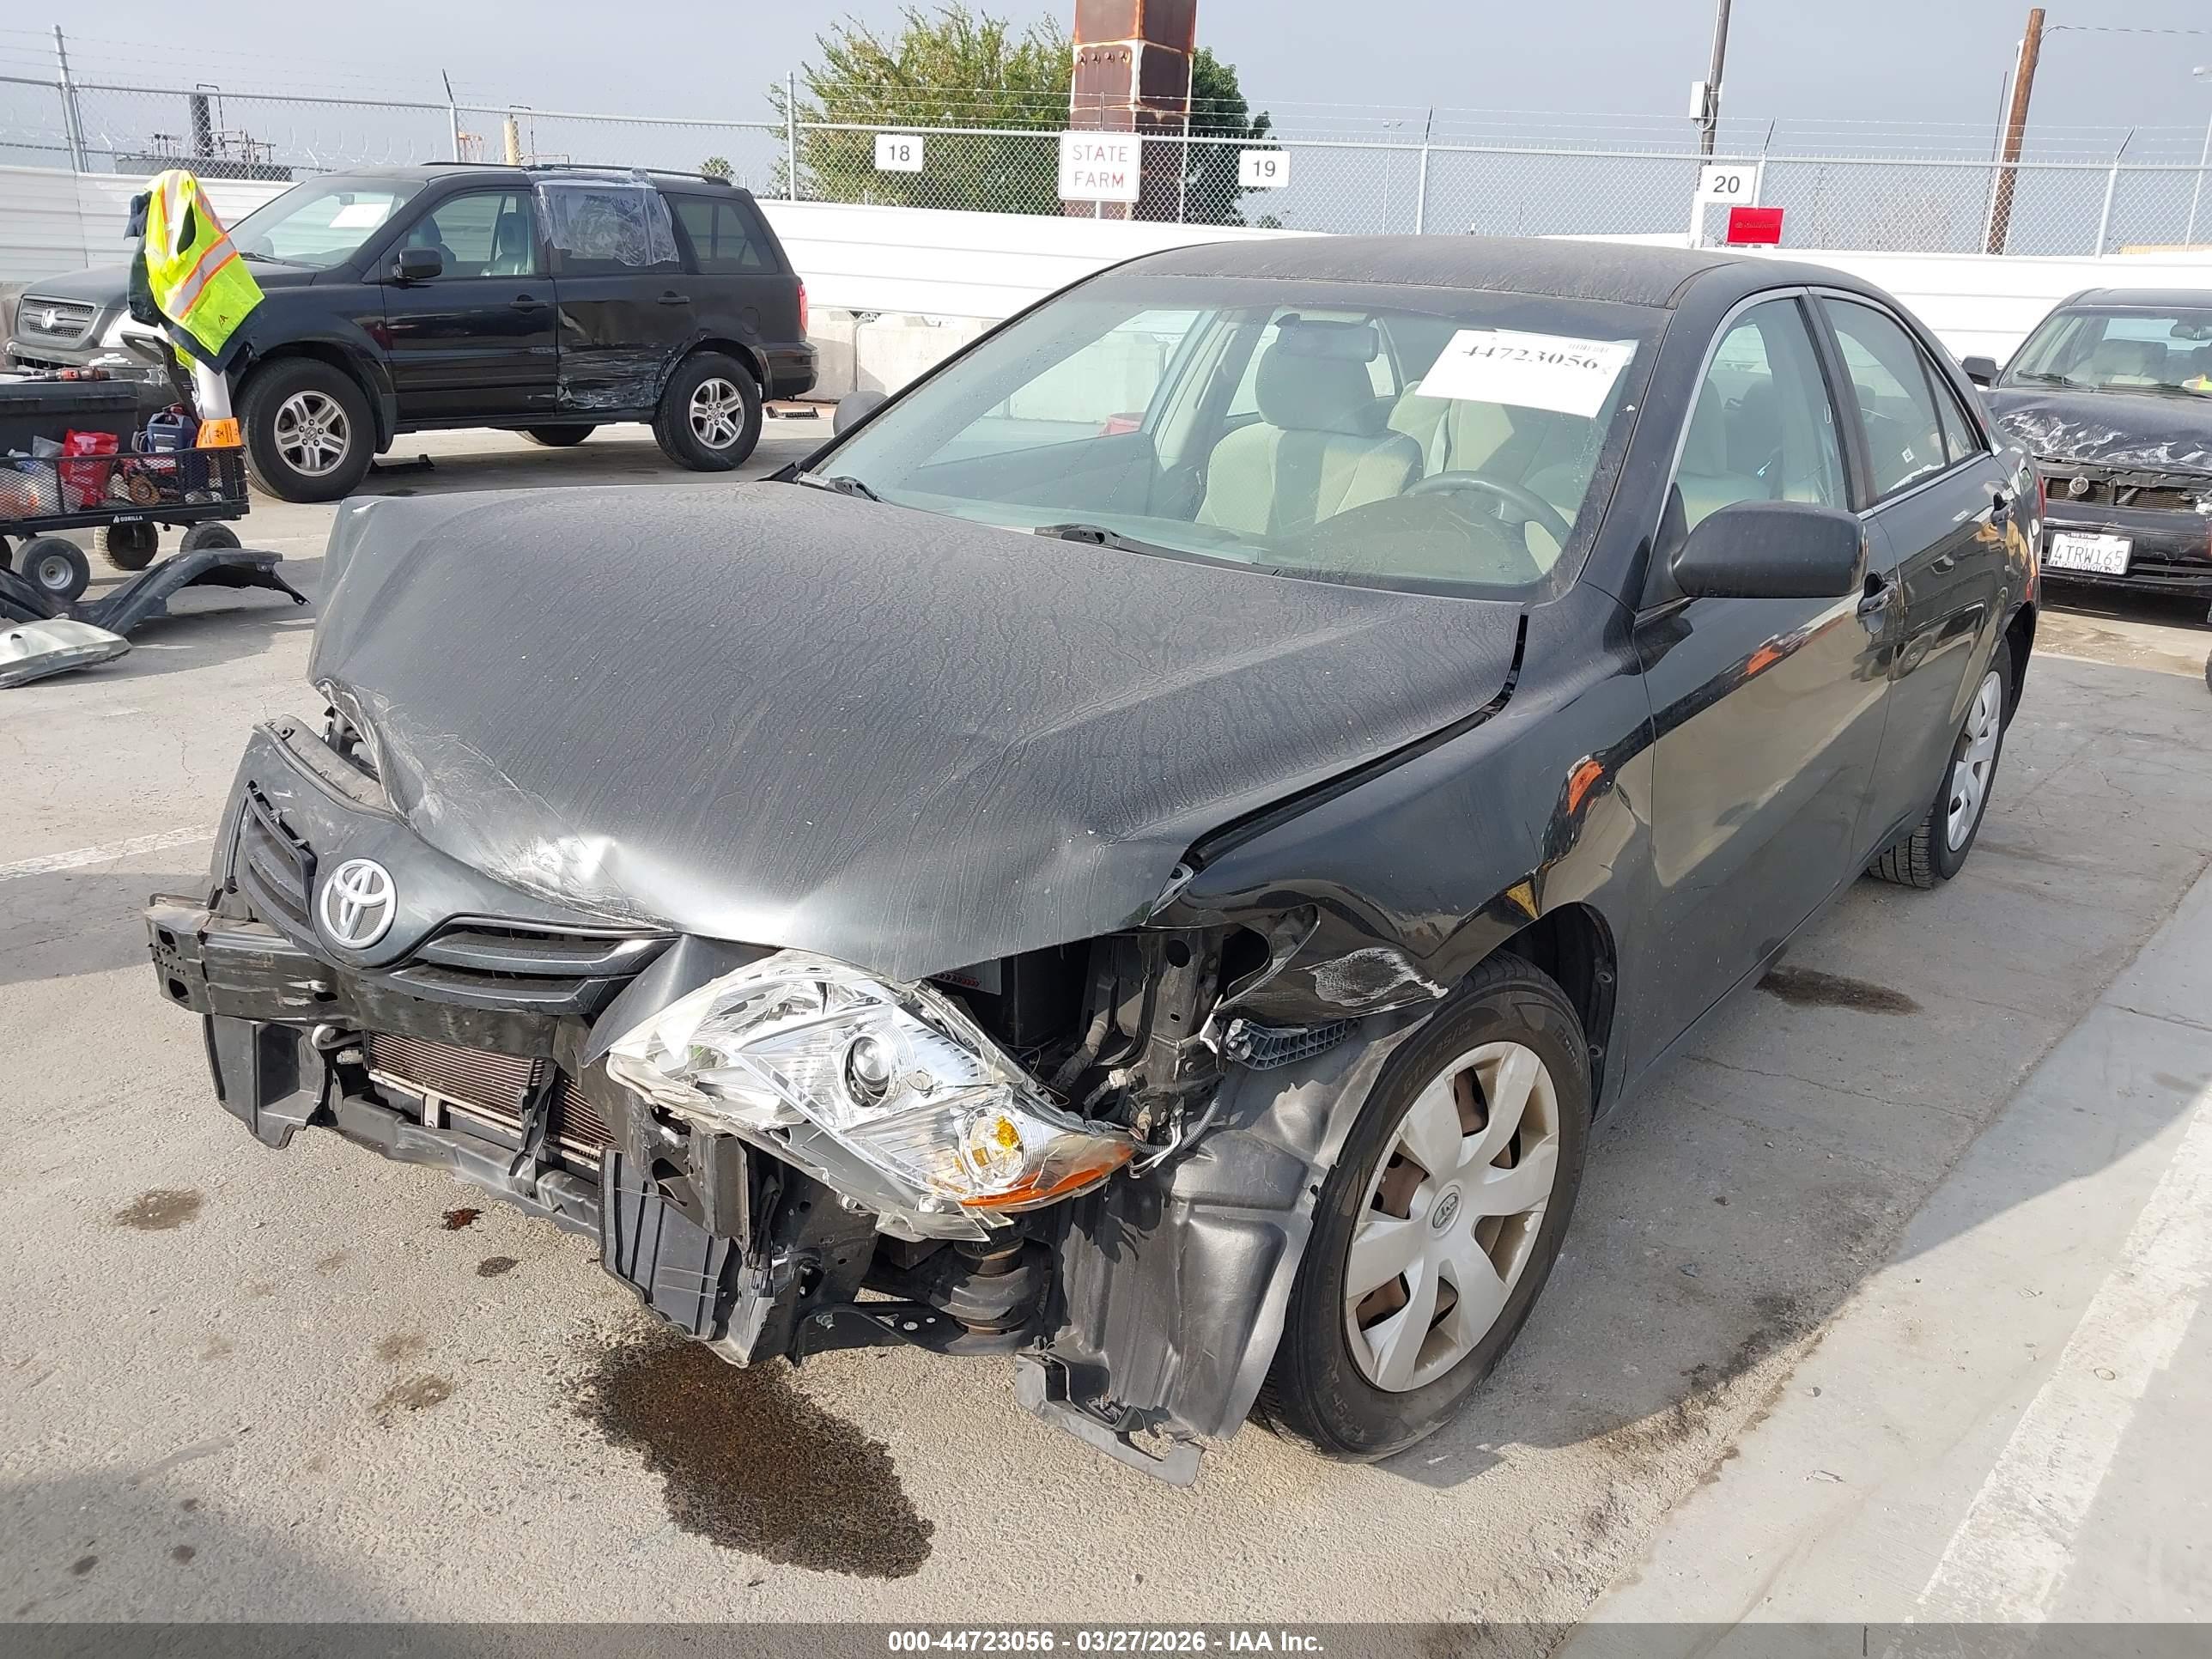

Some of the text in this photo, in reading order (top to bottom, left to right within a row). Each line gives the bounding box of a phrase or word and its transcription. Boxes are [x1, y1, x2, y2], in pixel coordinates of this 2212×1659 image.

[888, 144, 910, 161] 18
[1072, 144, 1128, 163] STATE
[1252, 161, 1276, 178] 19
[1074, 171, 1124, 189] FARM
[1713, 175, 1741, 193] 20
[2054, 544, 2124, 567] 4TRW165
